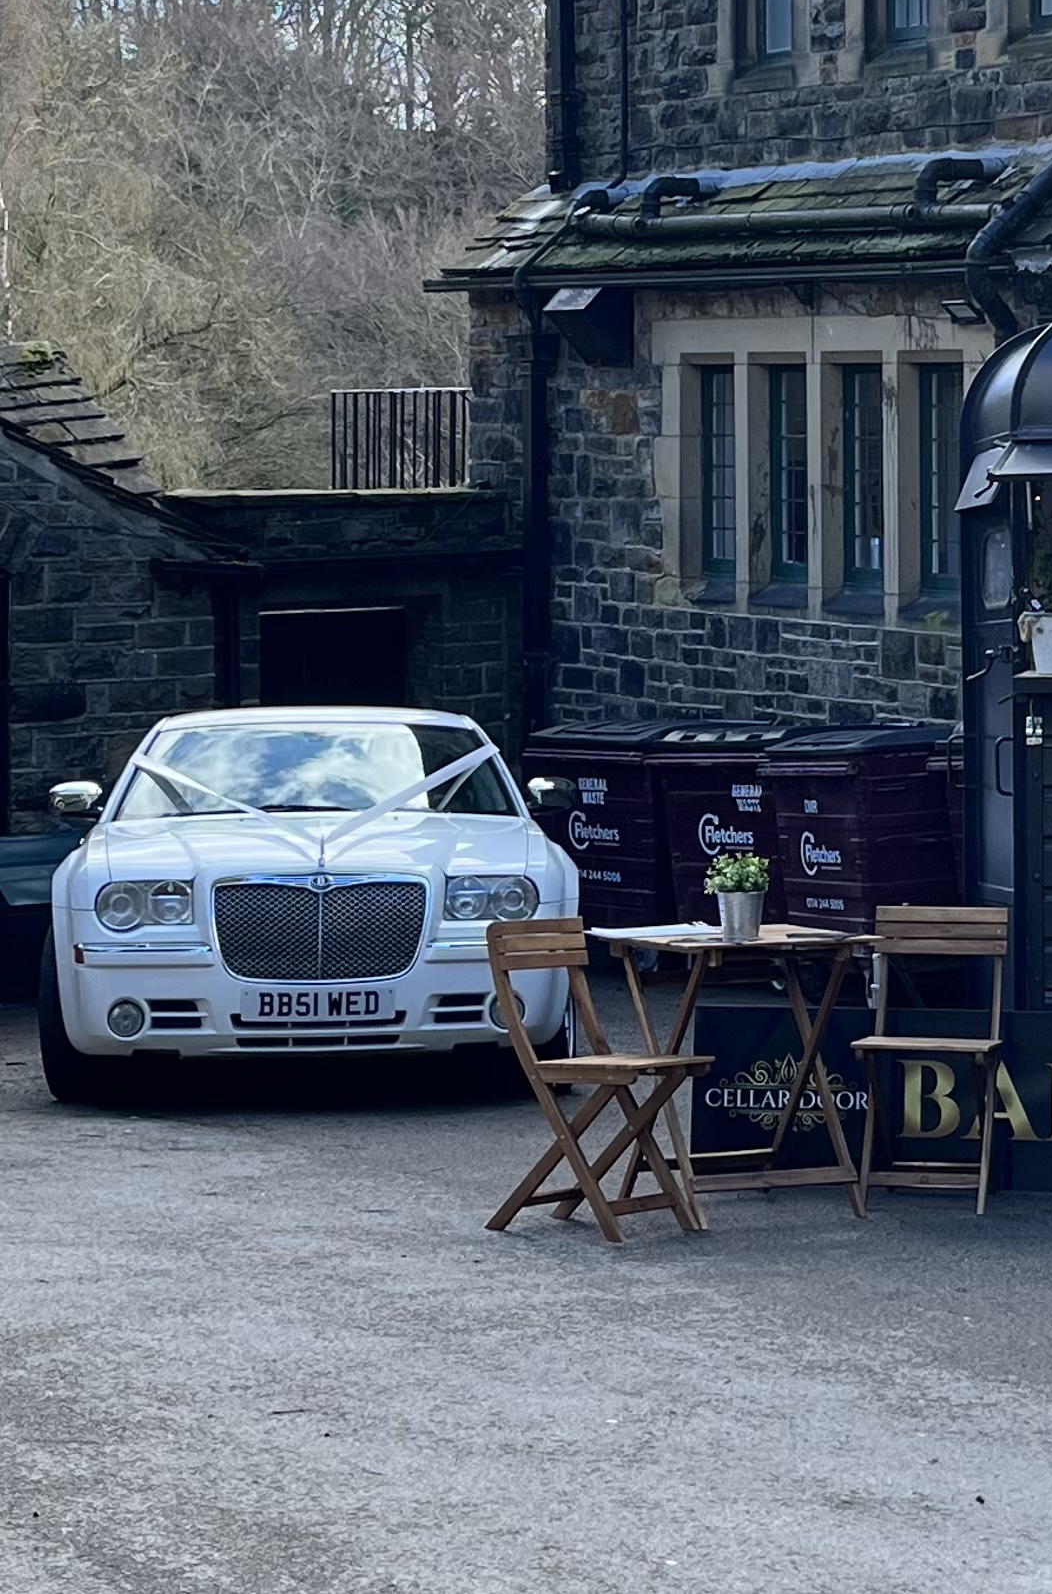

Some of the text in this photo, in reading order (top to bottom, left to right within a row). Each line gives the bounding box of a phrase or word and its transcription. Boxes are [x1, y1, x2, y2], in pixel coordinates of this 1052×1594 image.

[578, 777, 608, 791] GENERAL
[731, 784, 762, 797] GENERAL
[582, 791, 605, 805] WASTE
[574, 822, 619, 841] Fletchers
[705, 825, 754, 844] Fletchers
[805, 844, 841, 863] Fletchers
[258, 990, 380, 1017] BB51 WED
[705, 1088, 790, 1109] CELLAR
